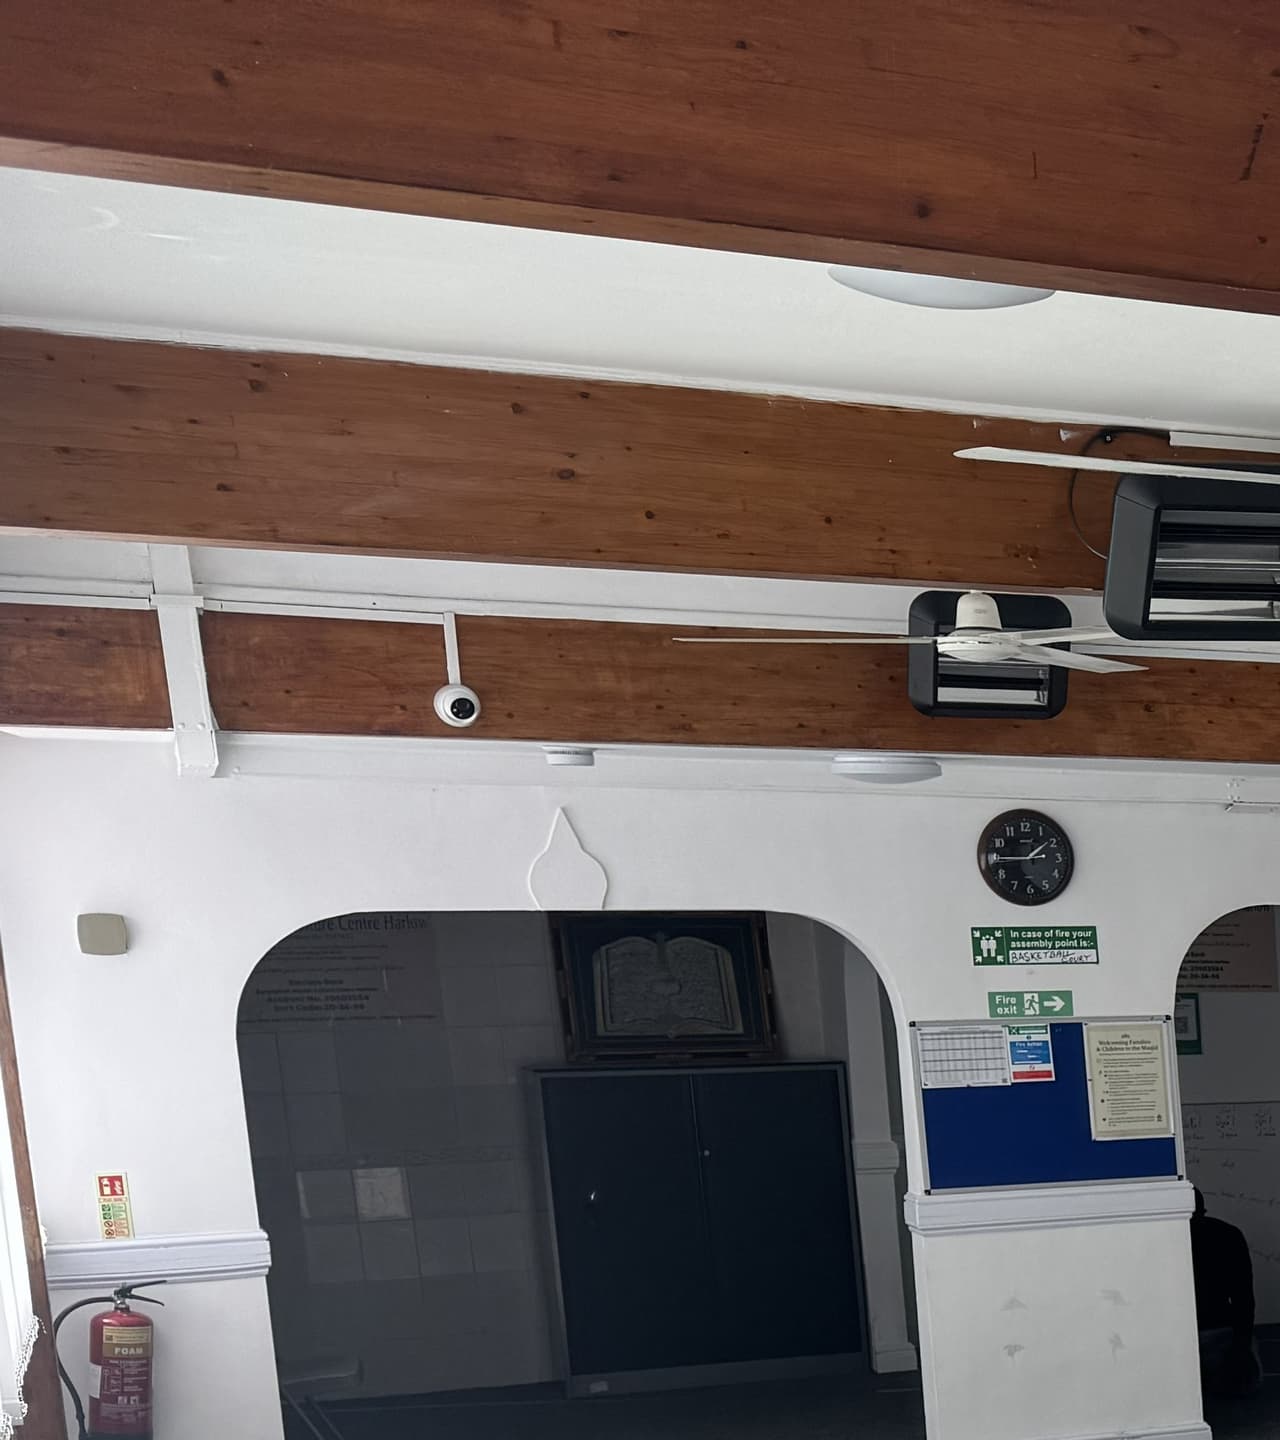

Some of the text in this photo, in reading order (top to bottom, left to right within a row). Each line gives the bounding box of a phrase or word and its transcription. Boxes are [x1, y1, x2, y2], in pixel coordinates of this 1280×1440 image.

[1006, 822, 1043, 837] 11 12 1
[994, 838, 1057, 848] 10 2
[1055, 853, 1062, 863] 3
[998, 869, 1006, 879] 8
[1010, 880, 1049, 894] 7 6 5
[1010, 929, 1092, 939] In case of fire your
[1010, 940, 1052, 949] assembly
[1055, 940, 1077, 949] point
[995, 995, 1017, 1004] Fire
[997, 1005, 1017, 1014] exit
[114, 1347, 143, 1355] FOAM
